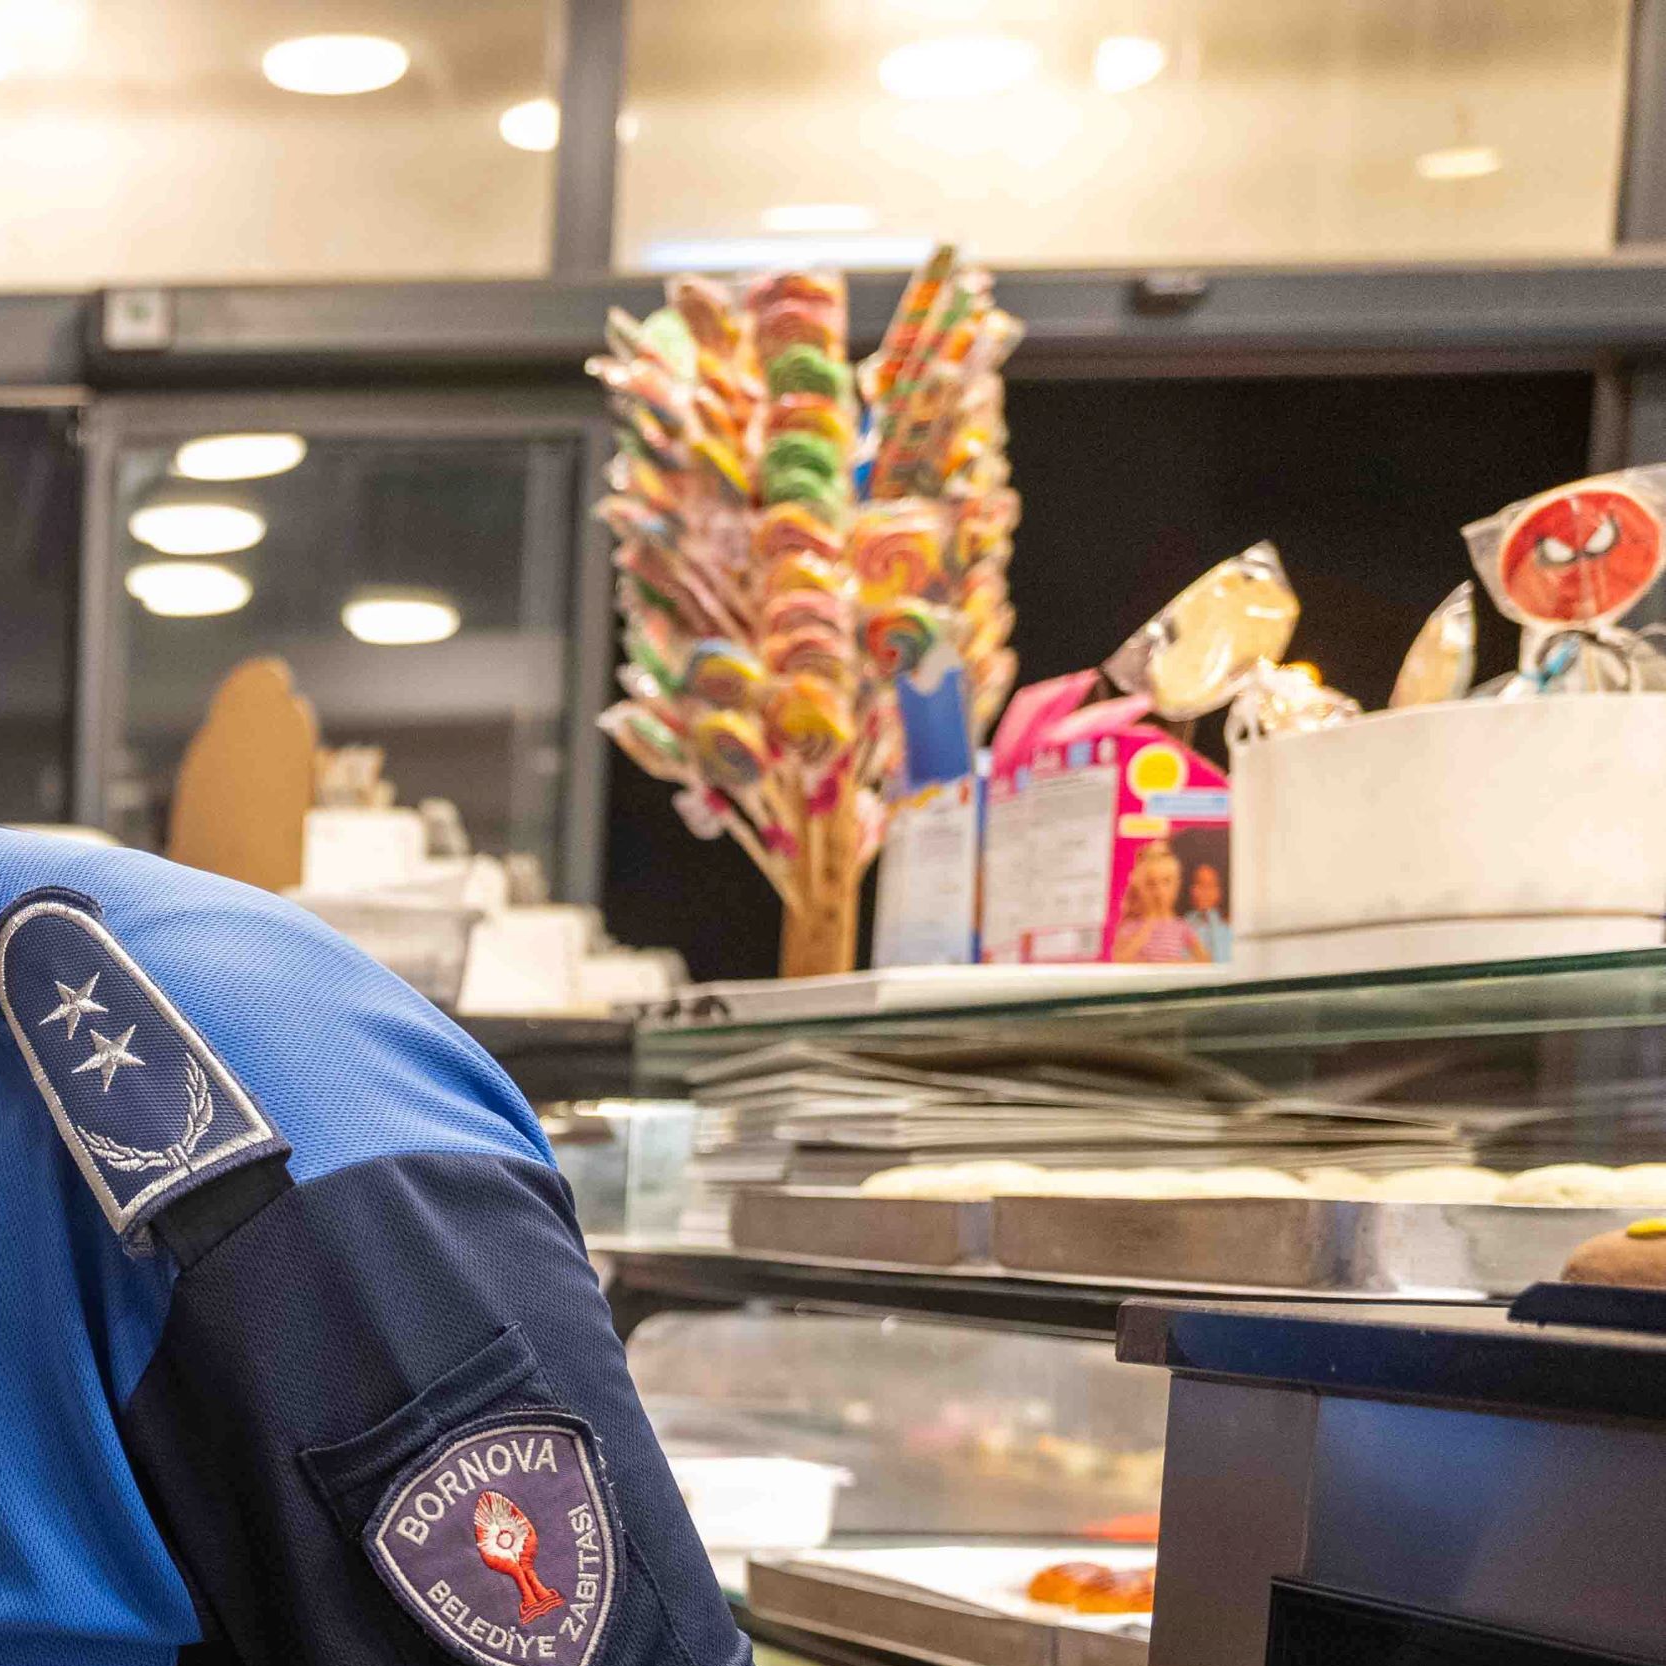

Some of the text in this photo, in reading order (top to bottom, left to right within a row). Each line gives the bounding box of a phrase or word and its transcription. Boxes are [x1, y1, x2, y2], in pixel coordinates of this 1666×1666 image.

[397, 1437, 559, 1547] BORNOVA
[426, 1577, 557, 1659] BELEDİYE
[559, 1502, 600, 1643] ZABITASI
